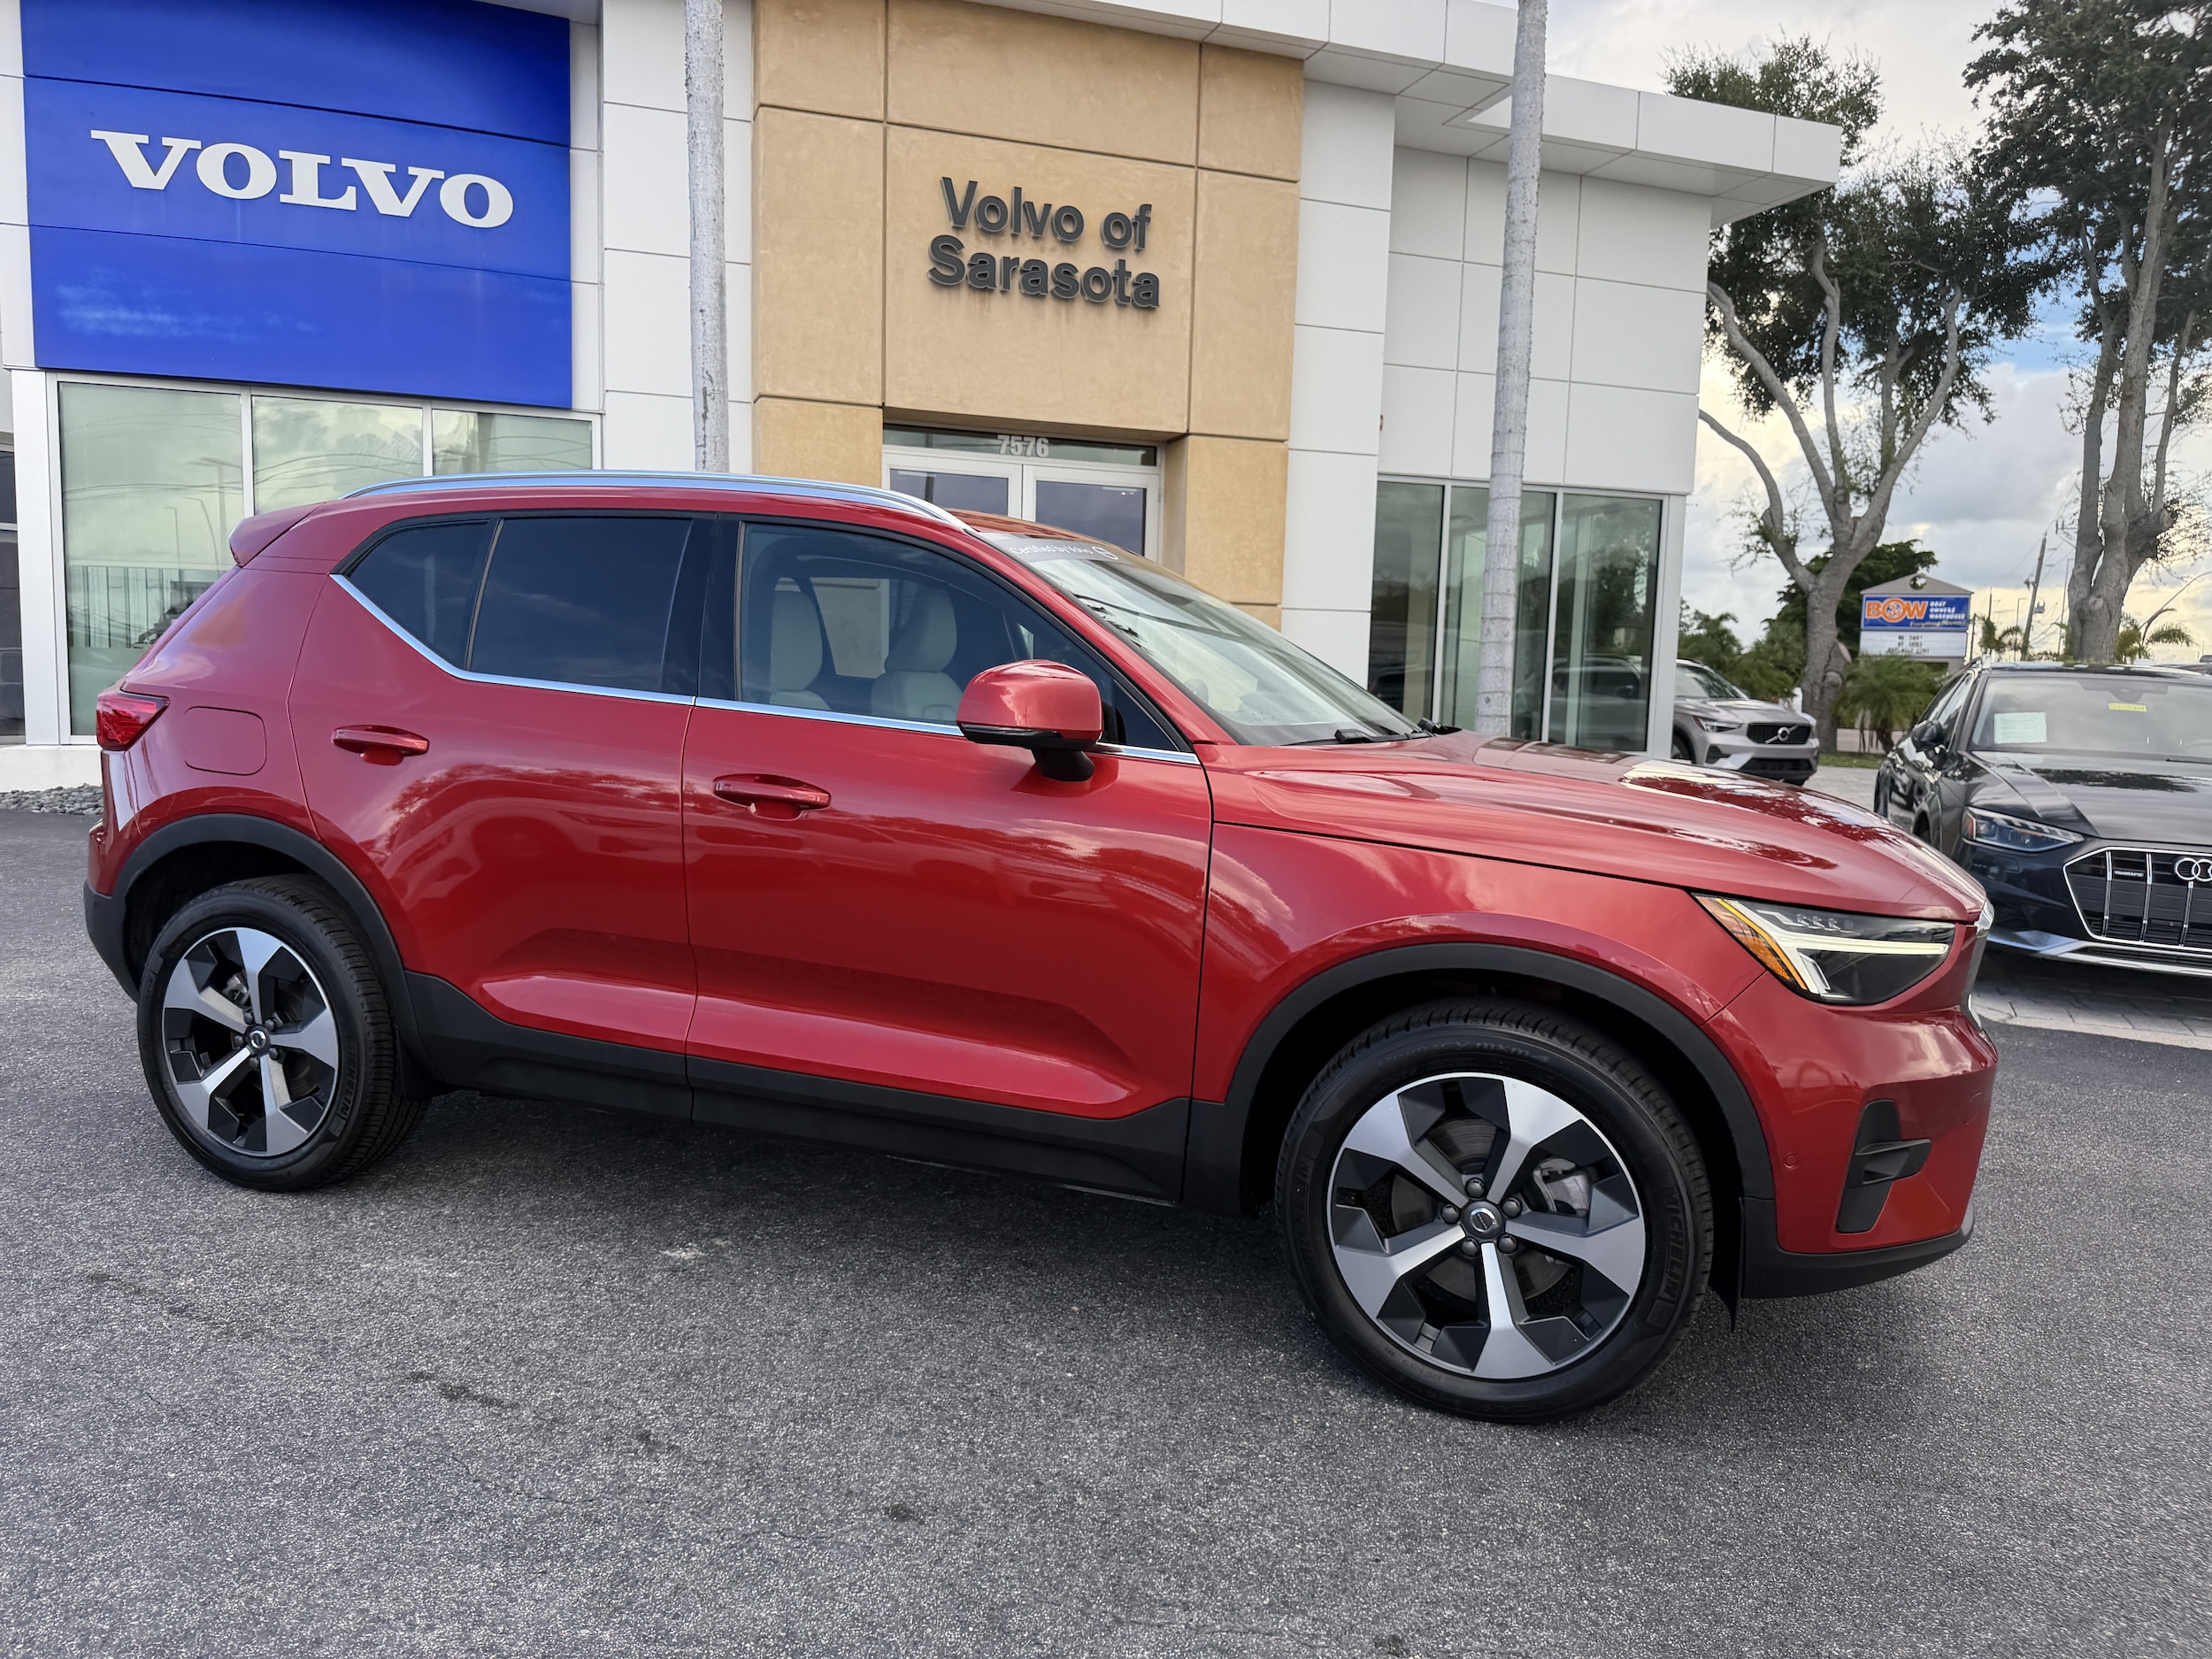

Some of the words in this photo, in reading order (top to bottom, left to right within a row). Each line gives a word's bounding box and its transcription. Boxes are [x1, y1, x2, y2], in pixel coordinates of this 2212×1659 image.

[90, 129, 515, 229] VOLVO
[940, 176, 1085, 243] Volvo
[1100, 204, 1153, 251] of
[926, 234, 1161, 310] Sarasota
[997, 434, 1050, 458] 7576
[1865, 597, 1929, 624] BOW
